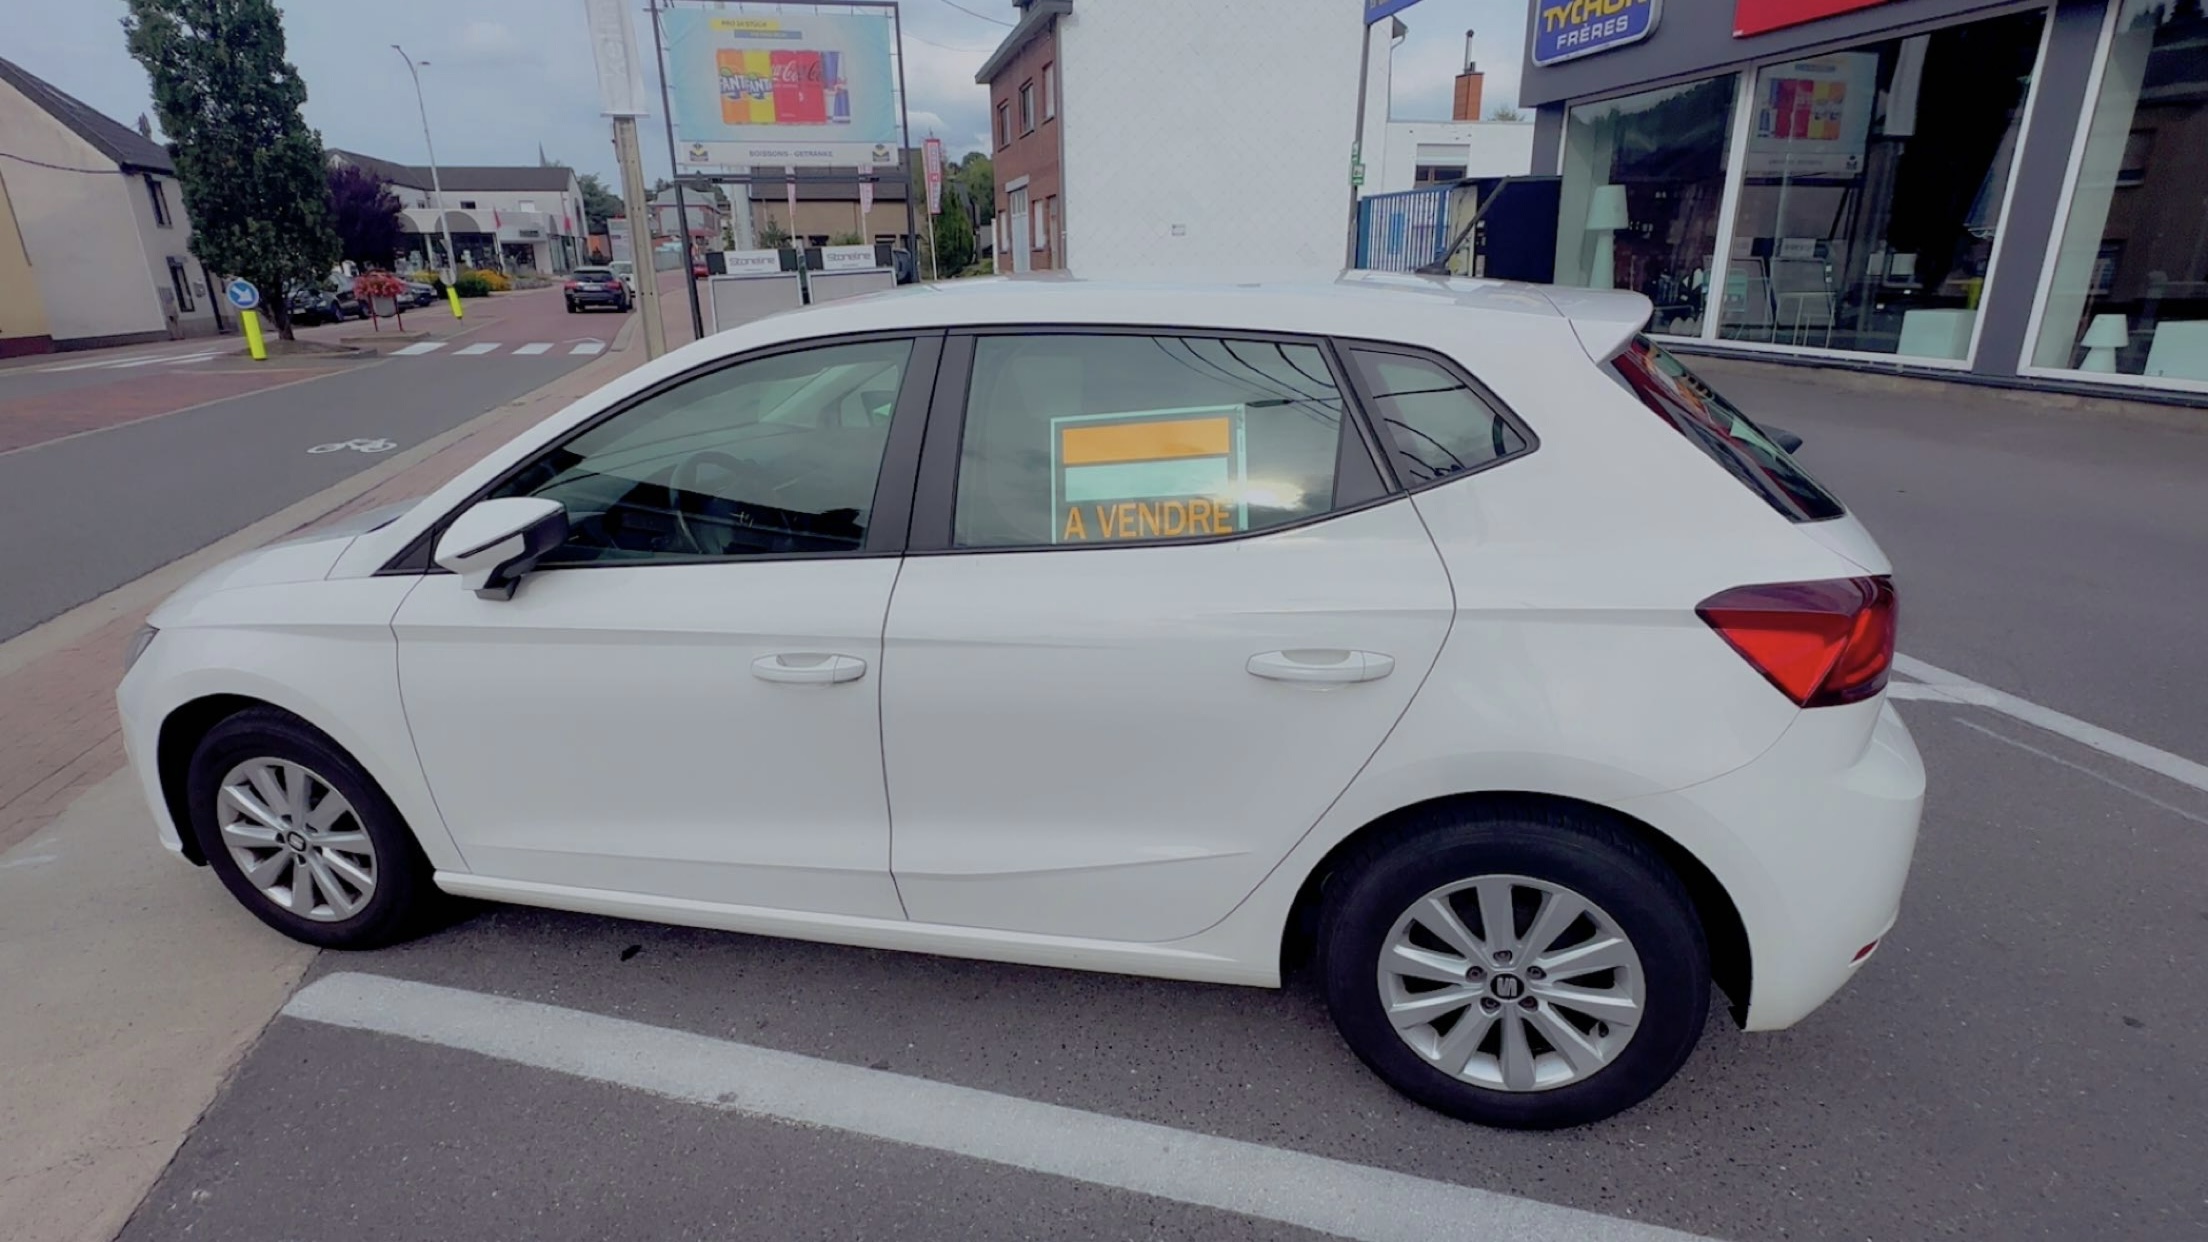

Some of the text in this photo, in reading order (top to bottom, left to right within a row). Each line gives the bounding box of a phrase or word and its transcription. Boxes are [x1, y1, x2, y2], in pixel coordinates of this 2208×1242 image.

[1543, 0, 1647, 32] TYCHO
[1556, 15, 1629, 50] FRÈRES
[749, 150, 789, 158] BOISSONS
[729, 256, 776, 267] Stoneline
[827, 251, 871, 262] Stoneline
[1064, 498, 1233, 540] A VENDRE
